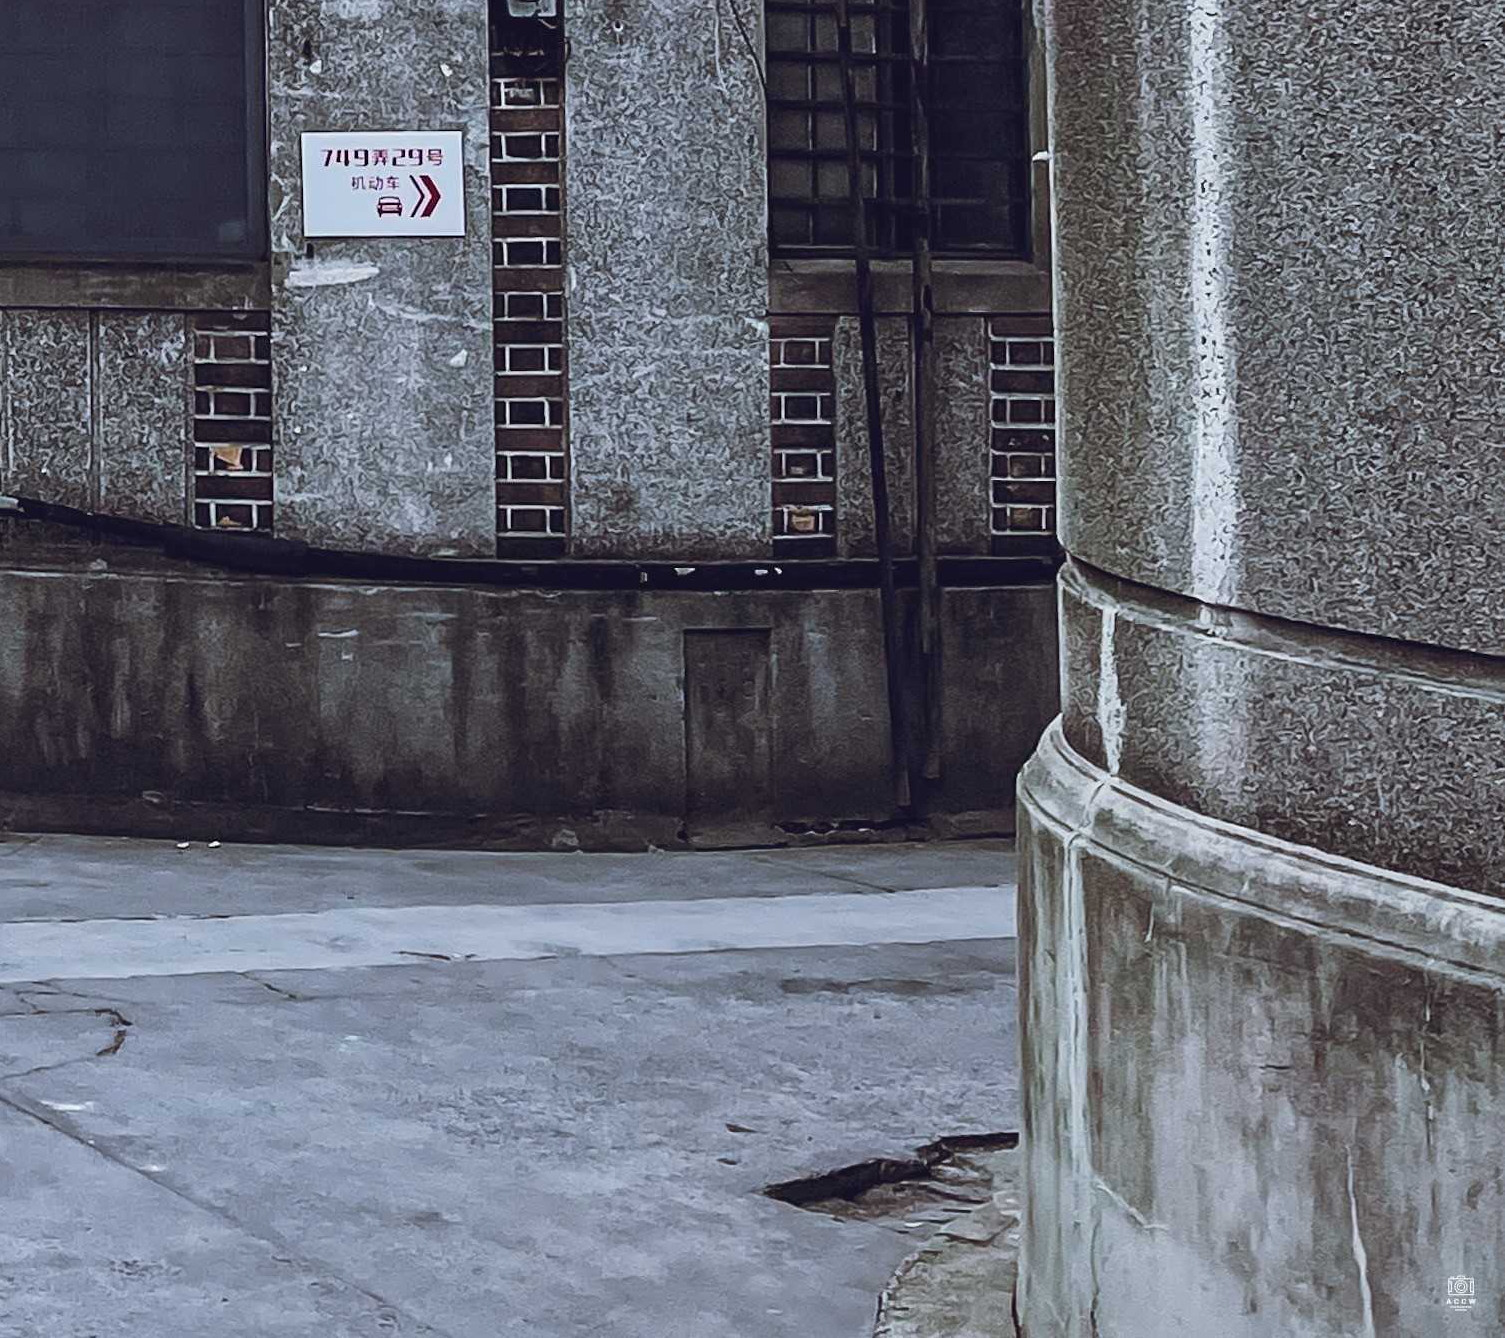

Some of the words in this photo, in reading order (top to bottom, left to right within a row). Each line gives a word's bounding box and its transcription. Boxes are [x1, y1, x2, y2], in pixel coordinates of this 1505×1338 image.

[322, 148, 443, 167] 749弄29号
[351, 175, 400, 191] 机动车
